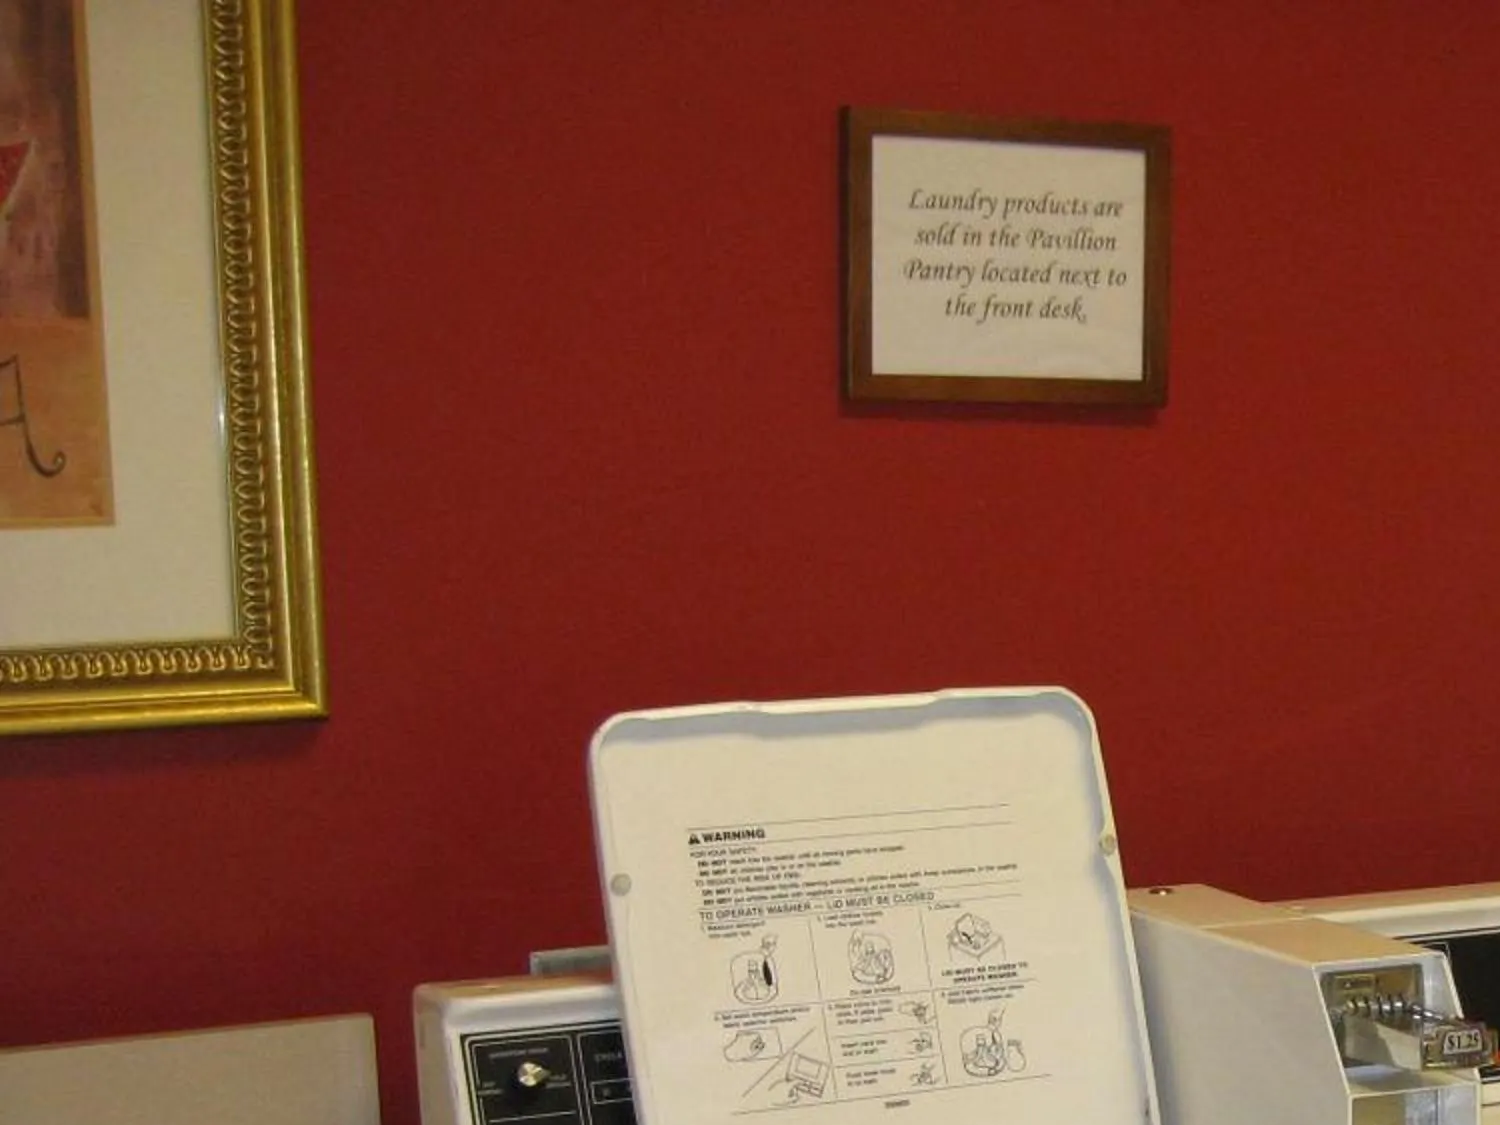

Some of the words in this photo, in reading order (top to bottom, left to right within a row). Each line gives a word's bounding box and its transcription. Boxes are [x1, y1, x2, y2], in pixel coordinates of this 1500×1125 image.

[908, 188, 999, 219] Laundry
[1002, 192, 1089, 221] products
[1092, 201, 1124, 218] are
[913, 222, 958, 246] sold
[961, 227, 982, 247] in
[988, 224, 1020, 249] the
[1024, 226, 1118, 251] Pavillion
[903, 258, 976, 289] Pantry
[980, 258, 1052, 285] located
[1057, 269, 1101, 290] next
[1106, 270, 1127, 287] to
[944, 293, 976, 317] the
[976, 294, 1034, 325] front
[702, 828, 766, 843] WARNING
[699, 910, 713, 922] TO
[715, 906, 763, 920] OPERATE
[765, 901, 812, 915] WASHER
[826, 899, 843, 910] LID
[845, 896, 873, 908] MUST
[876, 895, 890, 905] BE
[892, 891, 935, 904] CLOSED
[1446, 1029, 1480, 1051] $1.25
